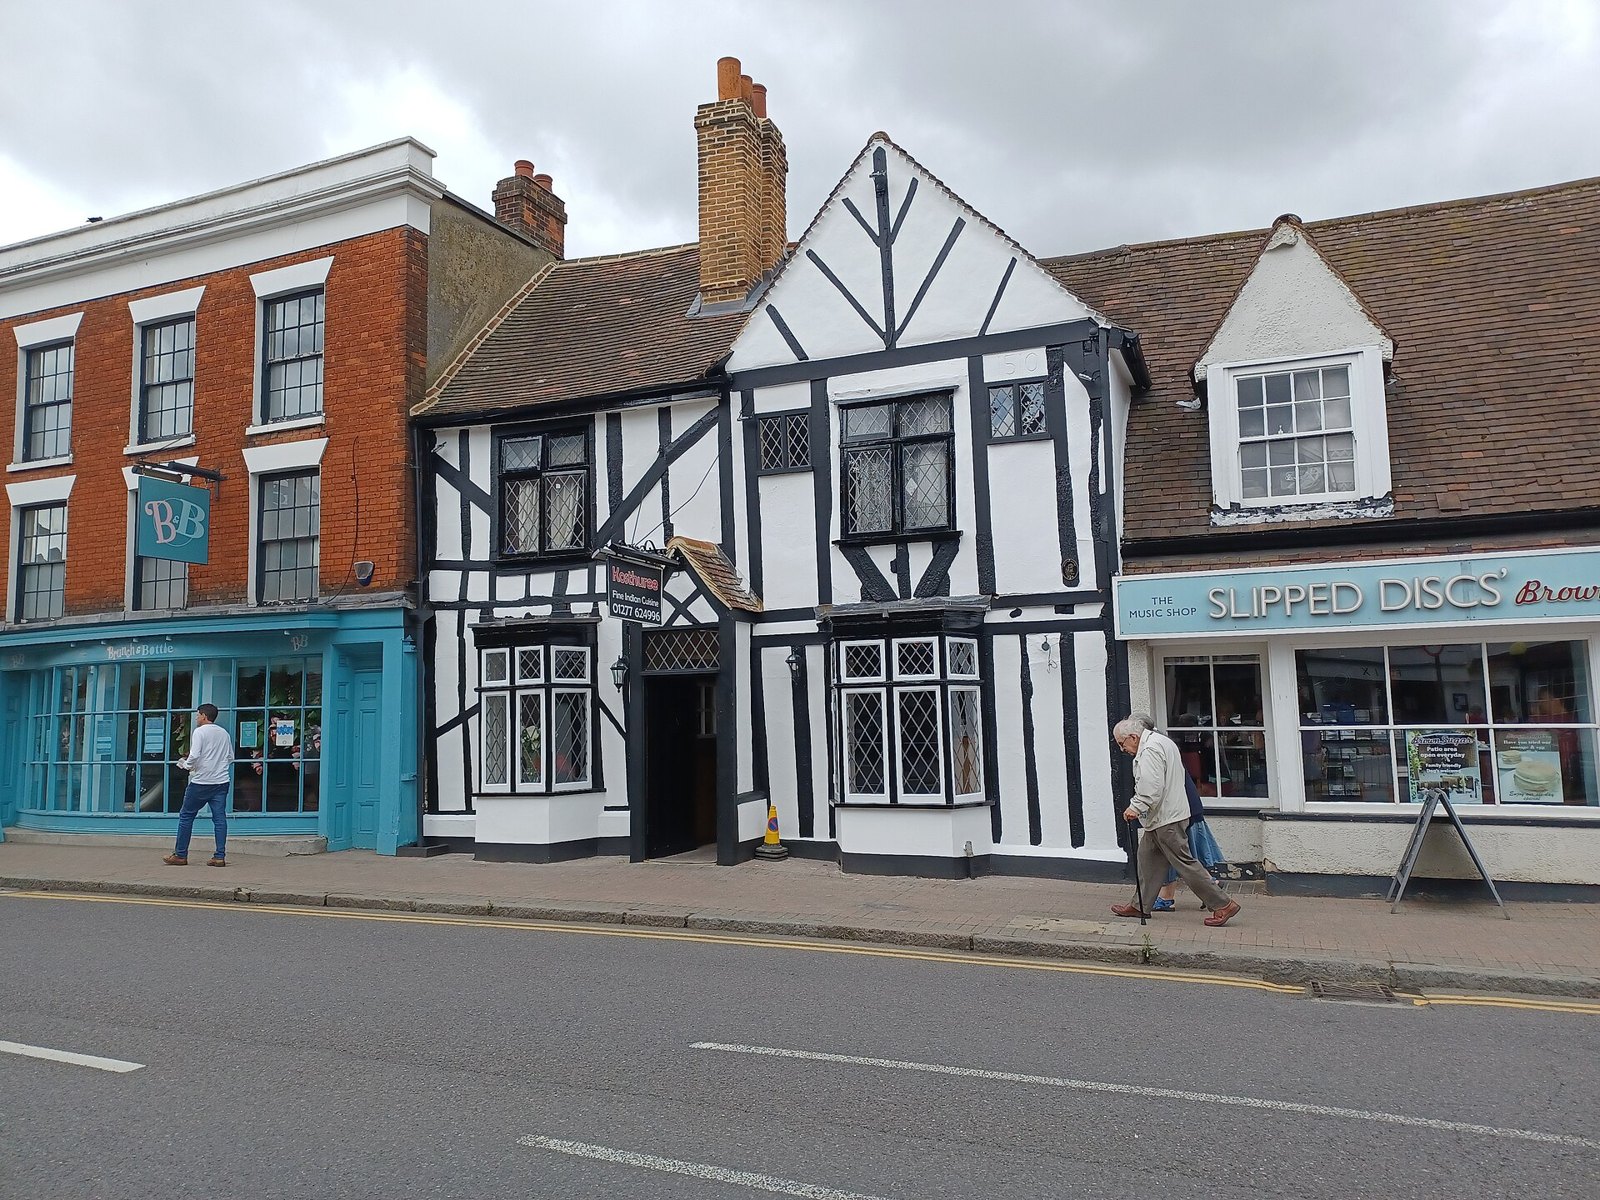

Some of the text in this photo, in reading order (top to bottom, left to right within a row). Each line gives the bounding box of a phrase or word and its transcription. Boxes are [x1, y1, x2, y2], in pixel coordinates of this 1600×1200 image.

[145, 499, 206, 544] B&B
[612, 589, 660, 608] Fine Indian Cuisine
[1151, 596, 1173, 606] THE
[1208, 581, 1364, 619] SLIPPED
[1514, 579, 1600, 605] Brow
[612, 603, 661, 622] 01277 624996
[1129, 607, 1197, 619] MUSIC SHOP
[142, 642, 174, 656] Bottle
